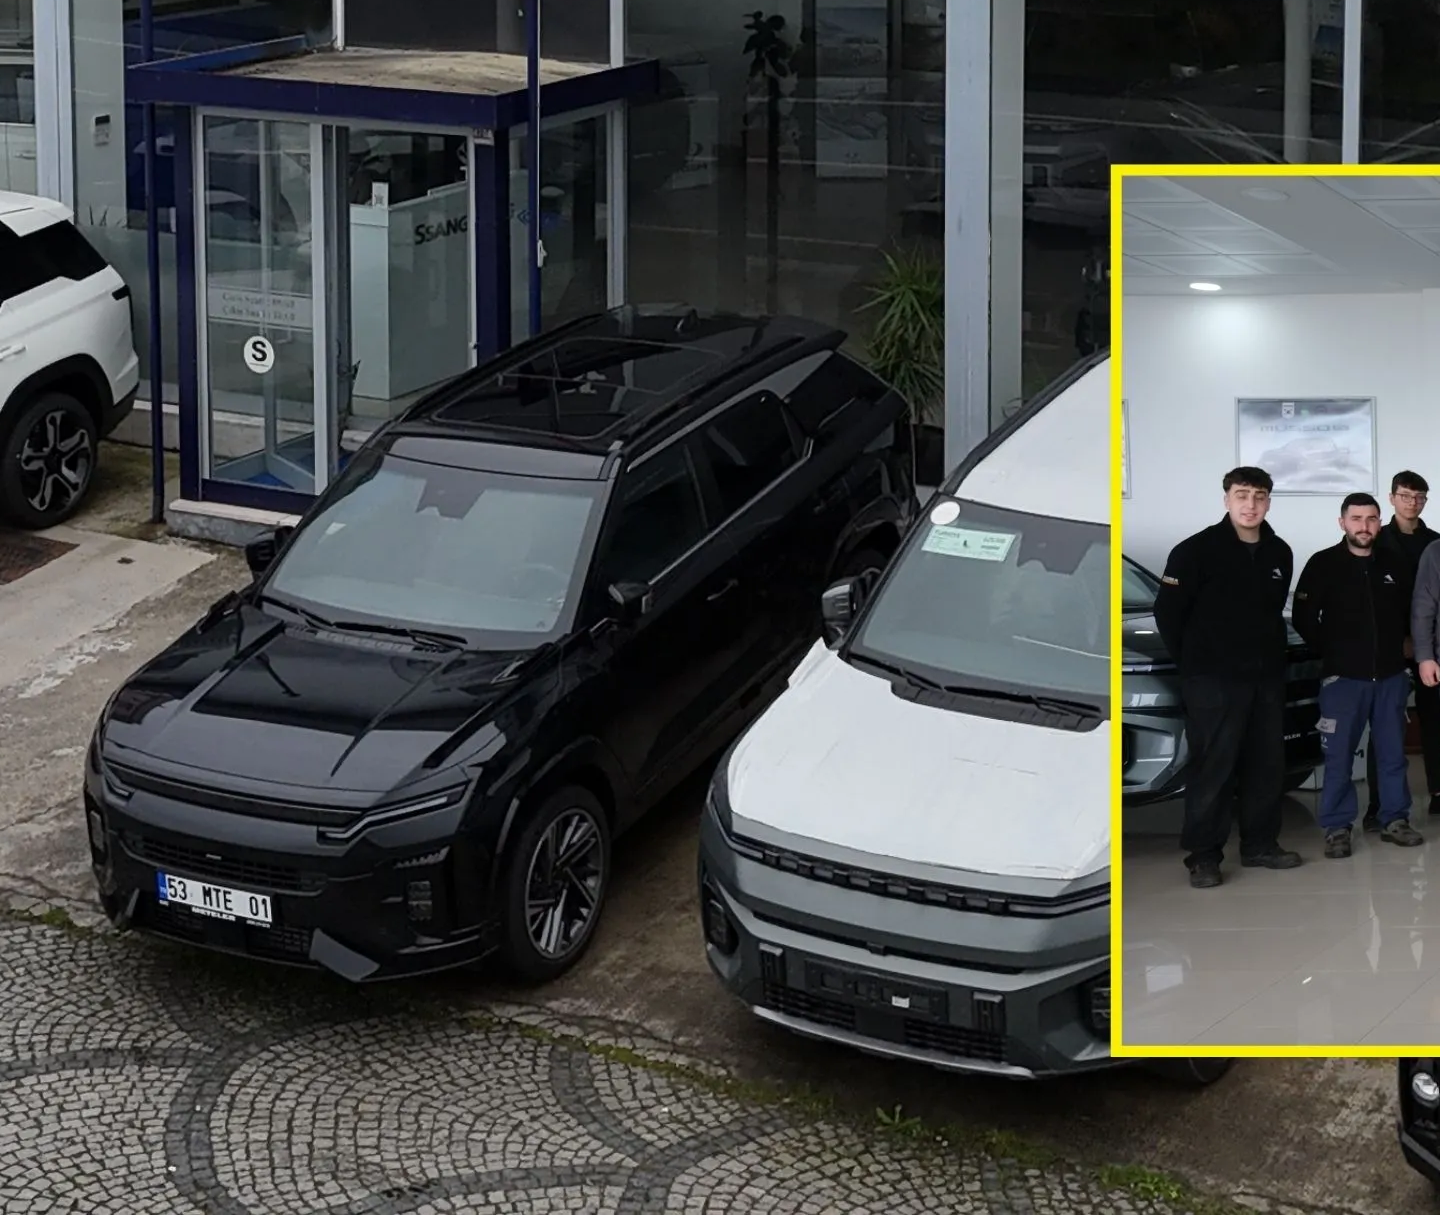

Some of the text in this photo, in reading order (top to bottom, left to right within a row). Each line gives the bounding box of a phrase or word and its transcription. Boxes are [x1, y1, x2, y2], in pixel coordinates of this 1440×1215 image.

[251, 340, 268, 362] S
[167, 877, 188, 900] 53
[202, 885, 234, 912] MTE
[248, 896, 269, 919] 01
